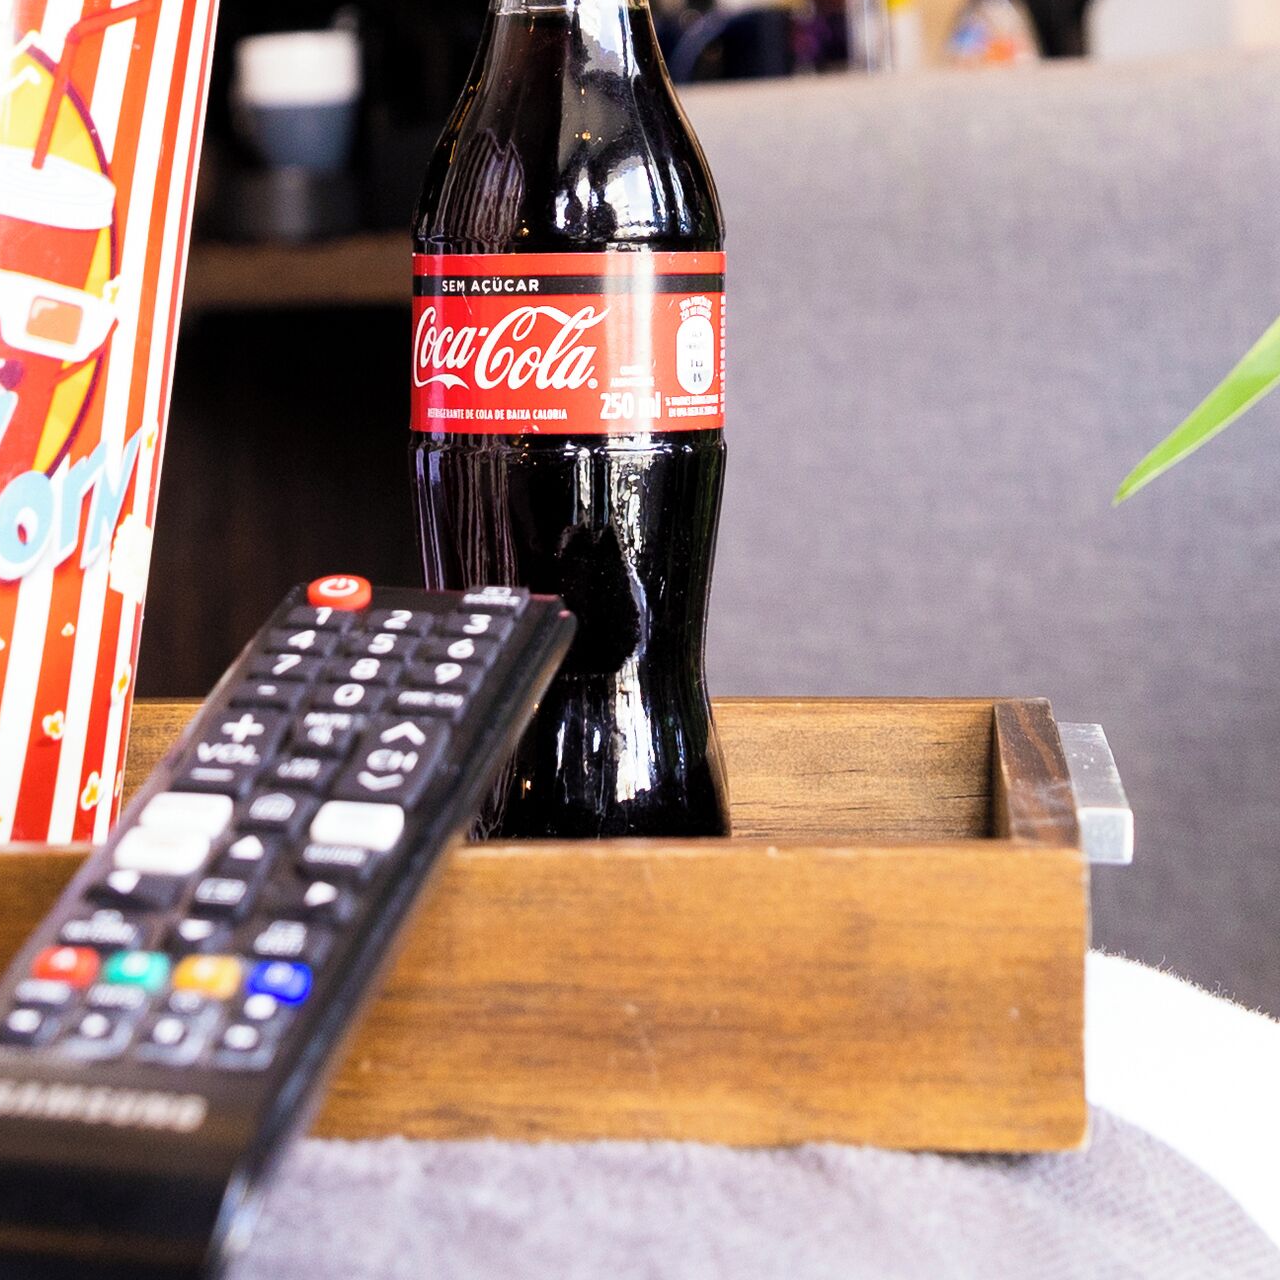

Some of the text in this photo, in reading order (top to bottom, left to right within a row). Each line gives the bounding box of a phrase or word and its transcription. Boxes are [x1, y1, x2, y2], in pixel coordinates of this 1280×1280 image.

[442, 279, 466, 293] SEM
[475, 409, 494, 420] COLA
[494, 409, 505, 420] DE
[506, 409, 531, 420] BAIXA
[532, 408, 568, 420] CALORIA
[599, 391, 635, 420] 250
[316, 607, 333, 625] 1
[383, 609, 413, 630] 2
[462, 613, 492, 634] 3
[287, 629, 317, 650] 4
[369, 633, 398, 654] 5
[447, 638, 475, 659] 6
[272, 653, 302, 675] 7
[349, 657, 381, 680] 8
[434, 662, 463, 685] 9
